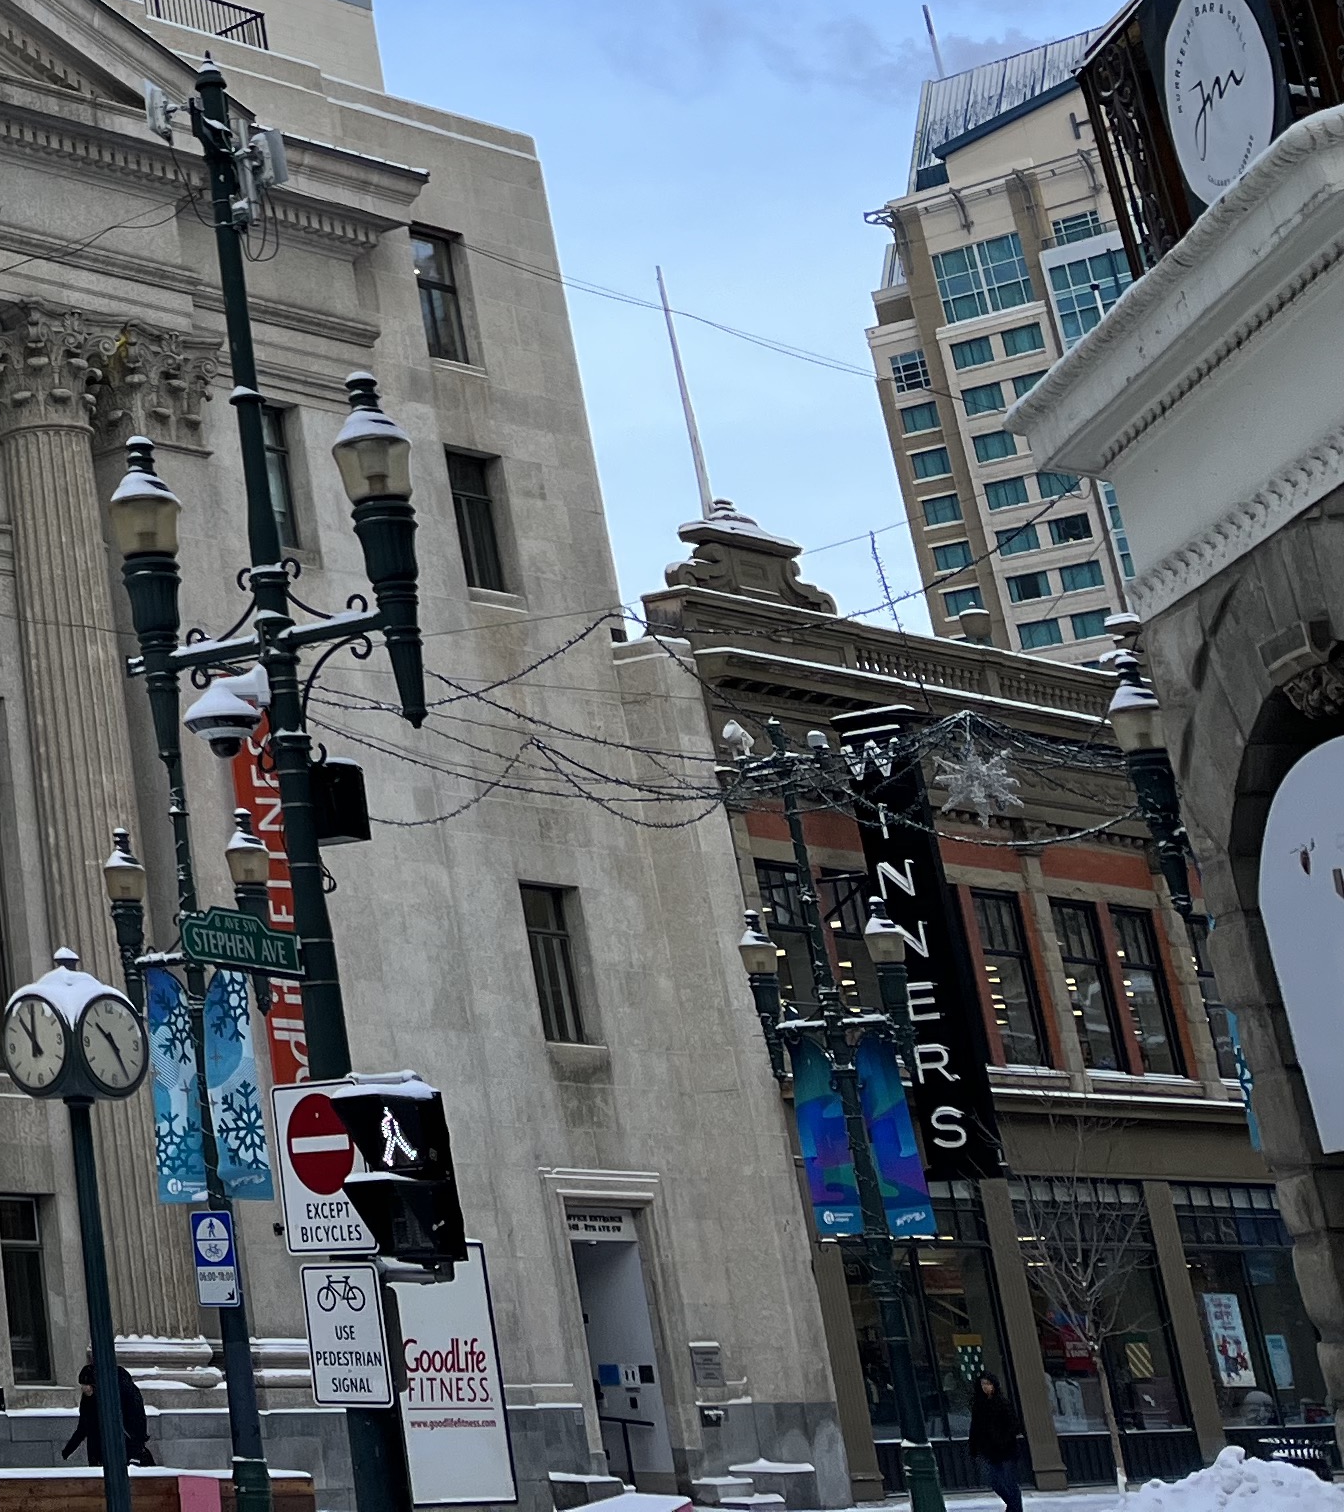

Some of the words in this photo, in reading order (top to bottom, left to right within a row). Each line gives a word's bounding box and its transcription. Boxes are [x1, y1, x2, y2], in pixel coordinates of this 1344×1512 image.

[1194, 2, 1215, 17] BAR
[214, 915, 221, 927] 8
[224, 917, 241, 931] AVE
[243, 920, 258, 933] SW
[192, 928, 256, 960] STEPHEN
[261, 938, 288, 965] AVE
[839, 738, 968, 1149] WINNERS
[56, 1033, 63, 1046] 3
[83, 1037, 91, 1048] 9
[132, 1040, 139, 1052] 3
[37, 1072, 44, 1085] 6
[306, 1201, 350, 1220] EXCEPT
[300, 1224, 363, 1243] BICYCLES
[334, 1325, 357, 1341] USE
[315, 1350, 383, 1367] PEDESTRIAN
[402, 1337, 487, 1374] GoodLife
[331, 1377, 373, 1393] SIGNAL
[408, 1377, 490, 1403] FITNESS
[409, 1417, 497, 1431] www.goodlifefitness.com
